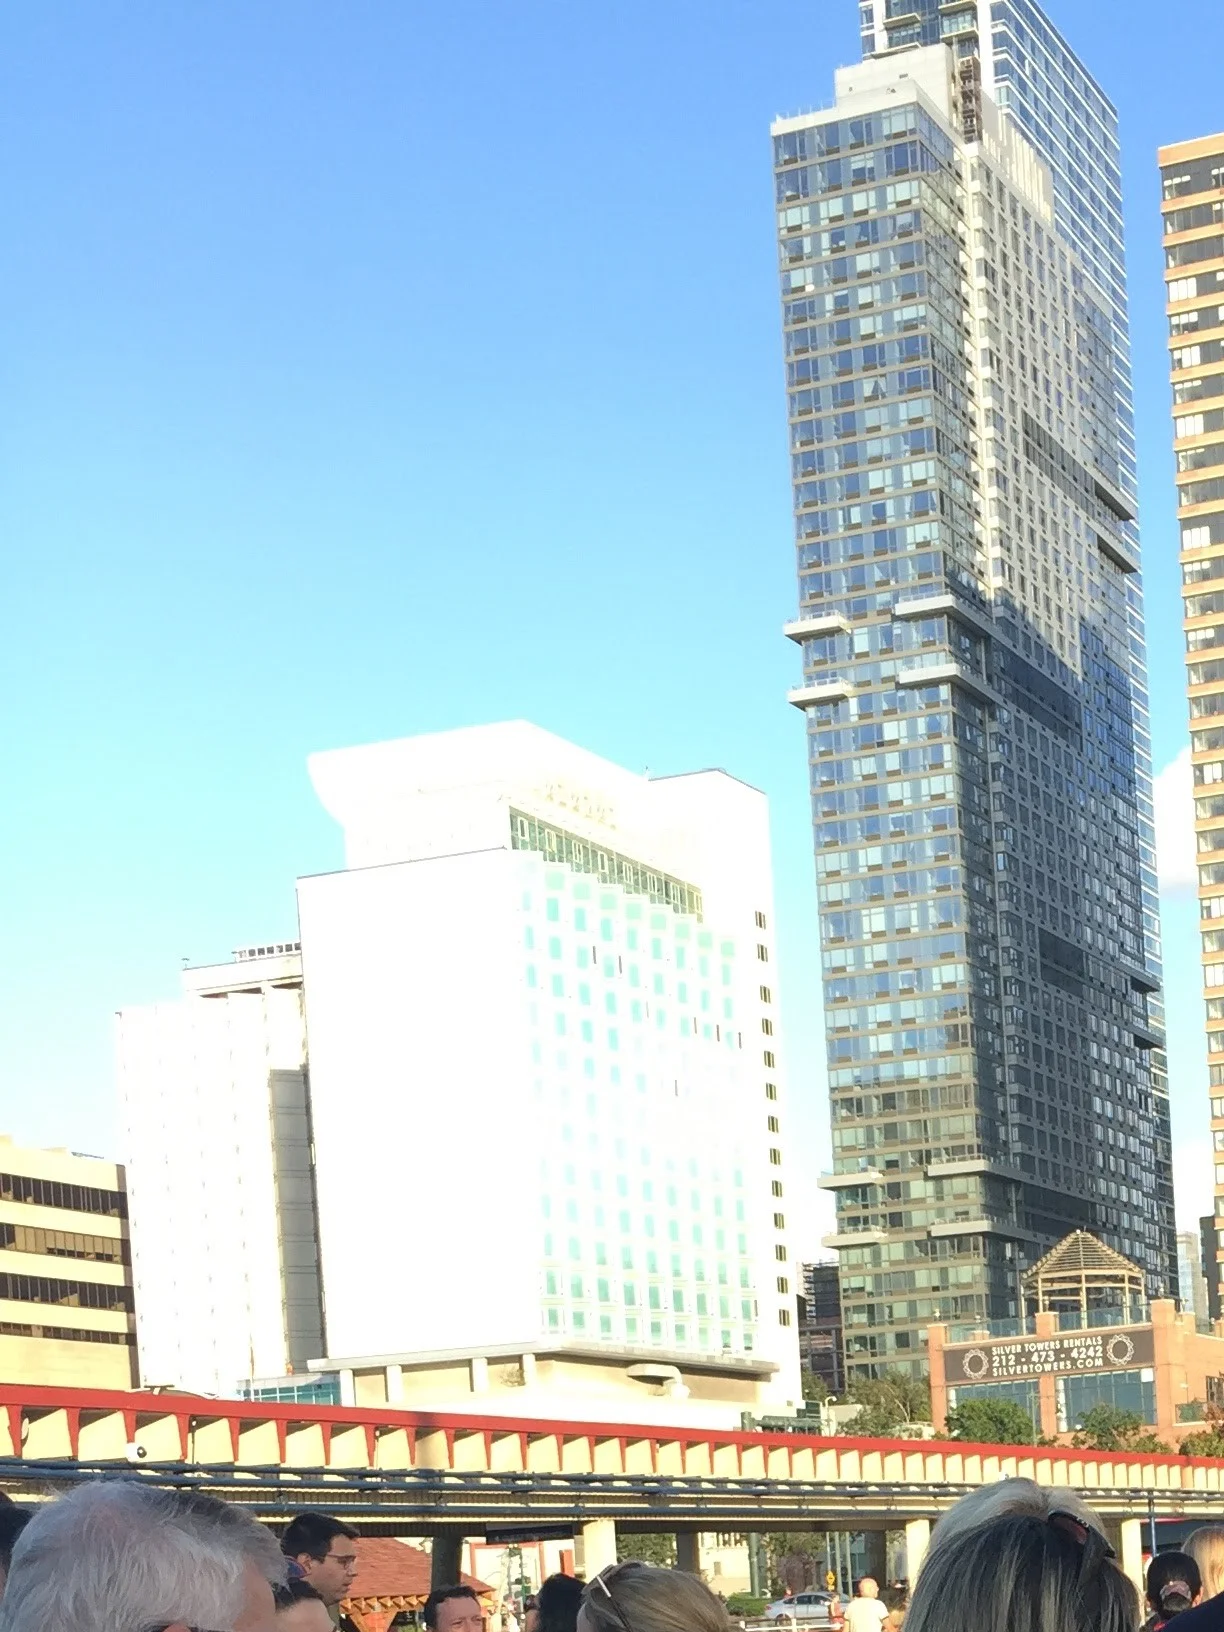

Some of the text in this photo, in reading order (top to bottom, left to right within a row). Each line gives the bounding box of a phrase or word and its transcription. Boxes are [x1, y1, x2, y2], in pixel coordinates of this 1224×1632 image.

[991, 1336, 1102, 1356] SILVER TOWERS RENTALS
[992, 1354, 1016, 1367] 212
[1031, 1350, 1055, 1364] 473
[1070, 1346, 1103, 1359] 4242
[992, 1358, 1104, 1377] SILVERTOWERS.COM
